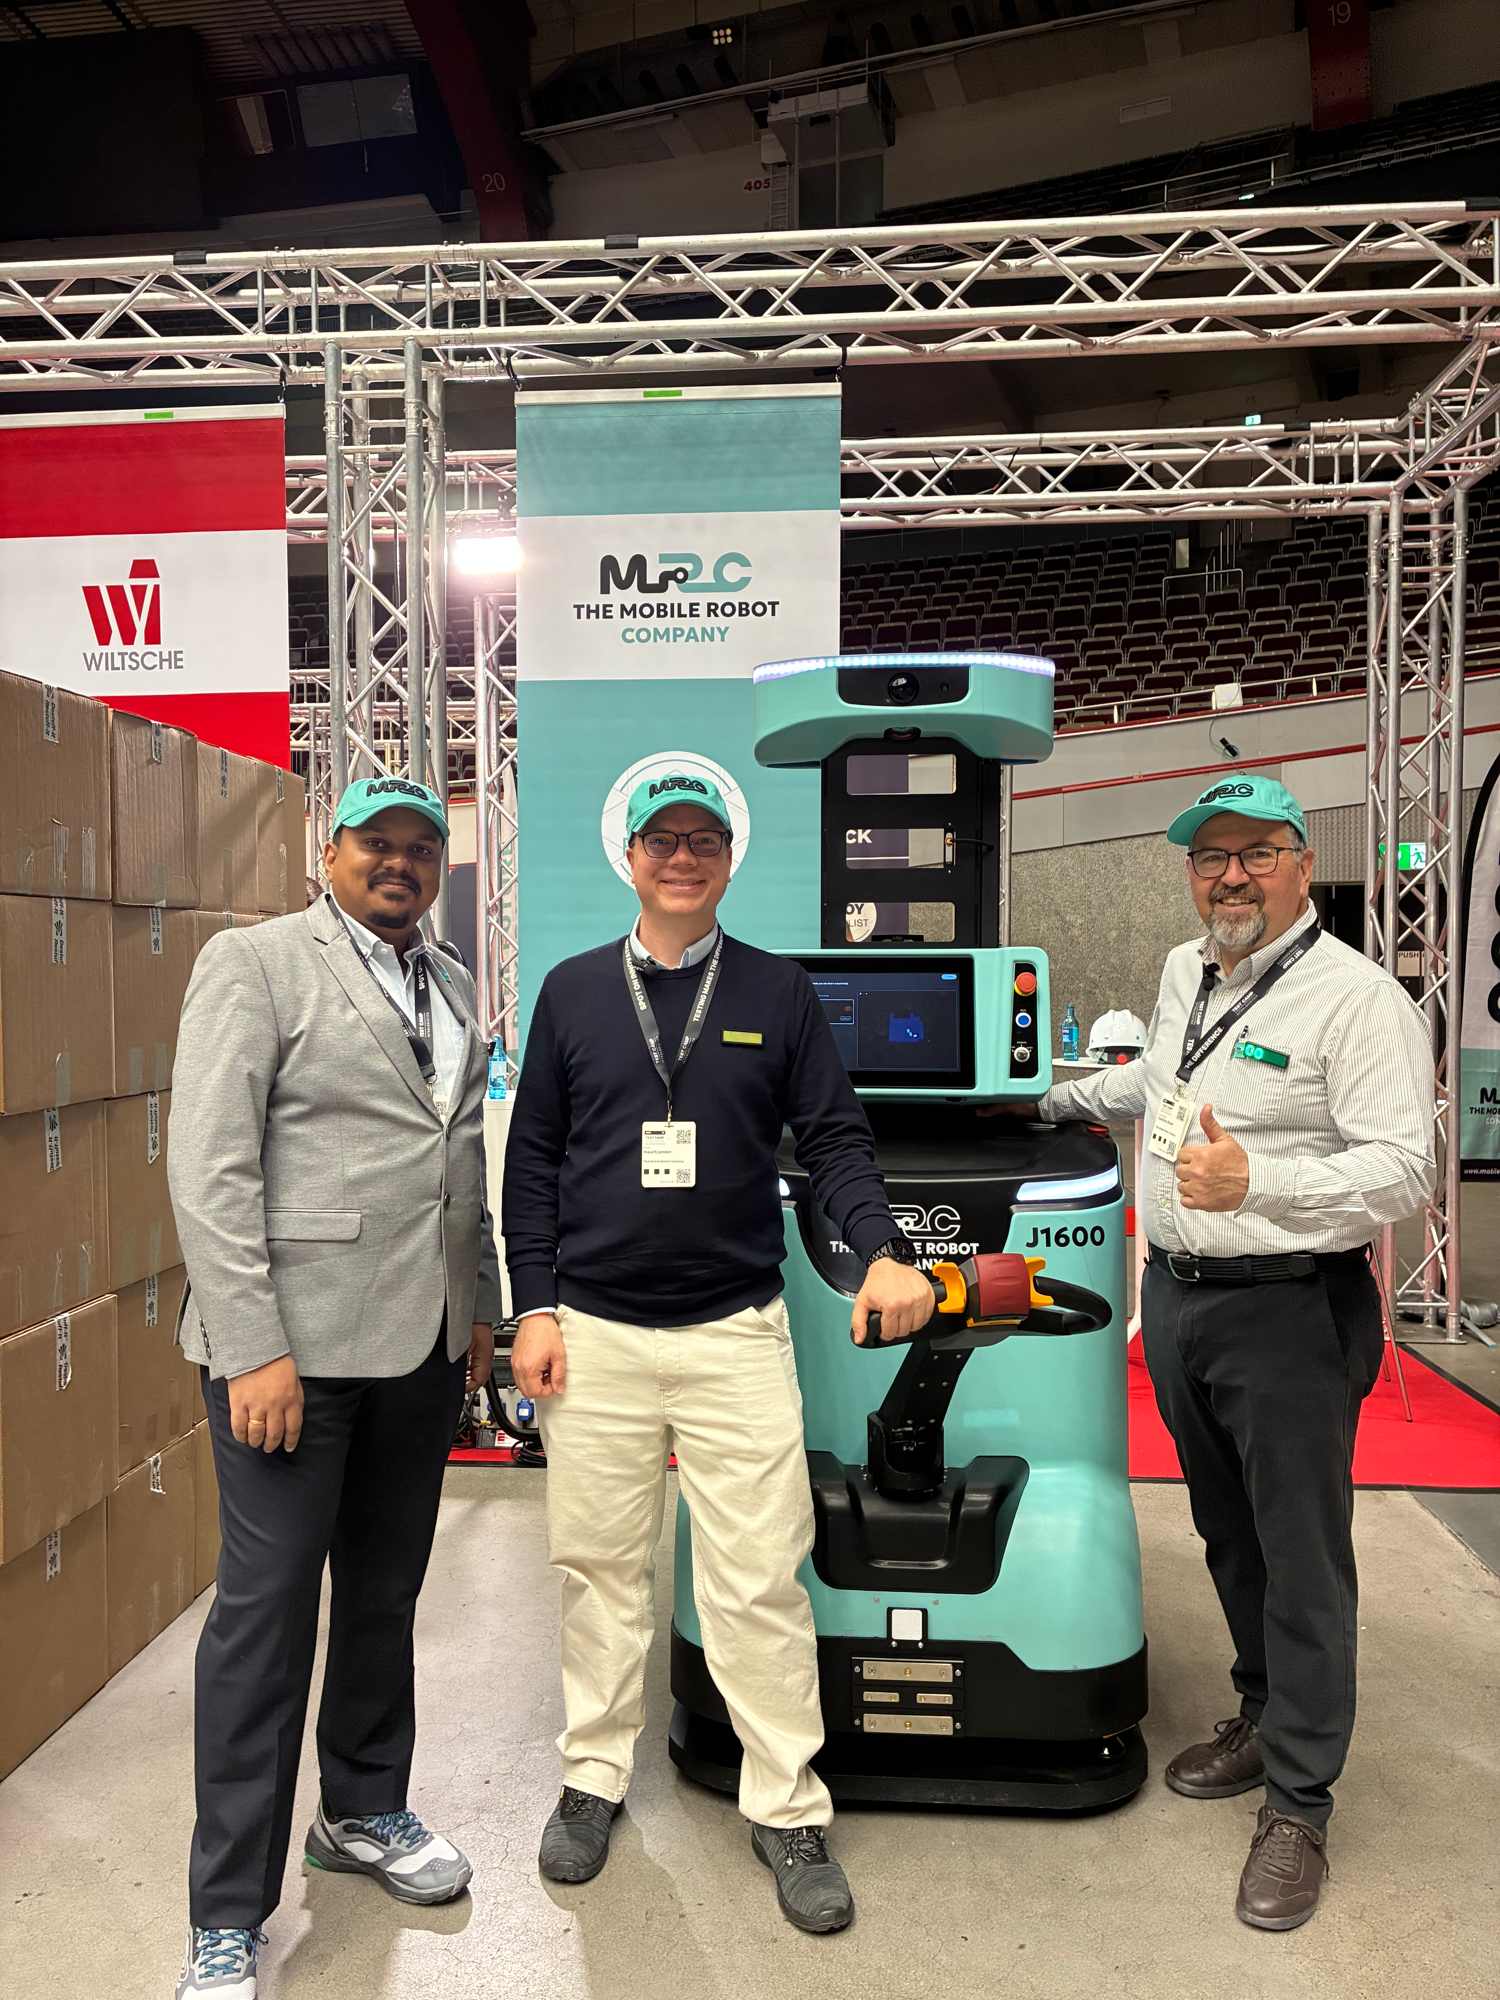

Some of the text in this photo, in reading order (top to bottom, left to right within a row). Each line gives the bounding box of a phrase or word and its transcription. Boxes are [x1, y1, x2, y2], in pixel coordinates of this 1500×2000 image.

[1328, 2, 1351, 26] 19
[482, 172, 506, 193] 20
[744, 178, 771, 192] 405
[573, 600, 780, 619] THE MOBILE ROBOT
[621, 626, 730, 644] COMPANY
[82, 650, 184, 671] WILTSCHE
[1282, 948, 1304, 970] TEST CAMP
[418, 972, 426, 990] SPOT
[632, 980, 640, 991] ON
[692, 994, 707, 1022] TESTING
[703, 972, 714, 996] MAKES
[709, 960, 718, 973] THE
[635, 990, 648, 1011] SPOT
[1025, 1225, 1106, 1248] J1600
[926, 1242, 980, 1256] ROBOT
